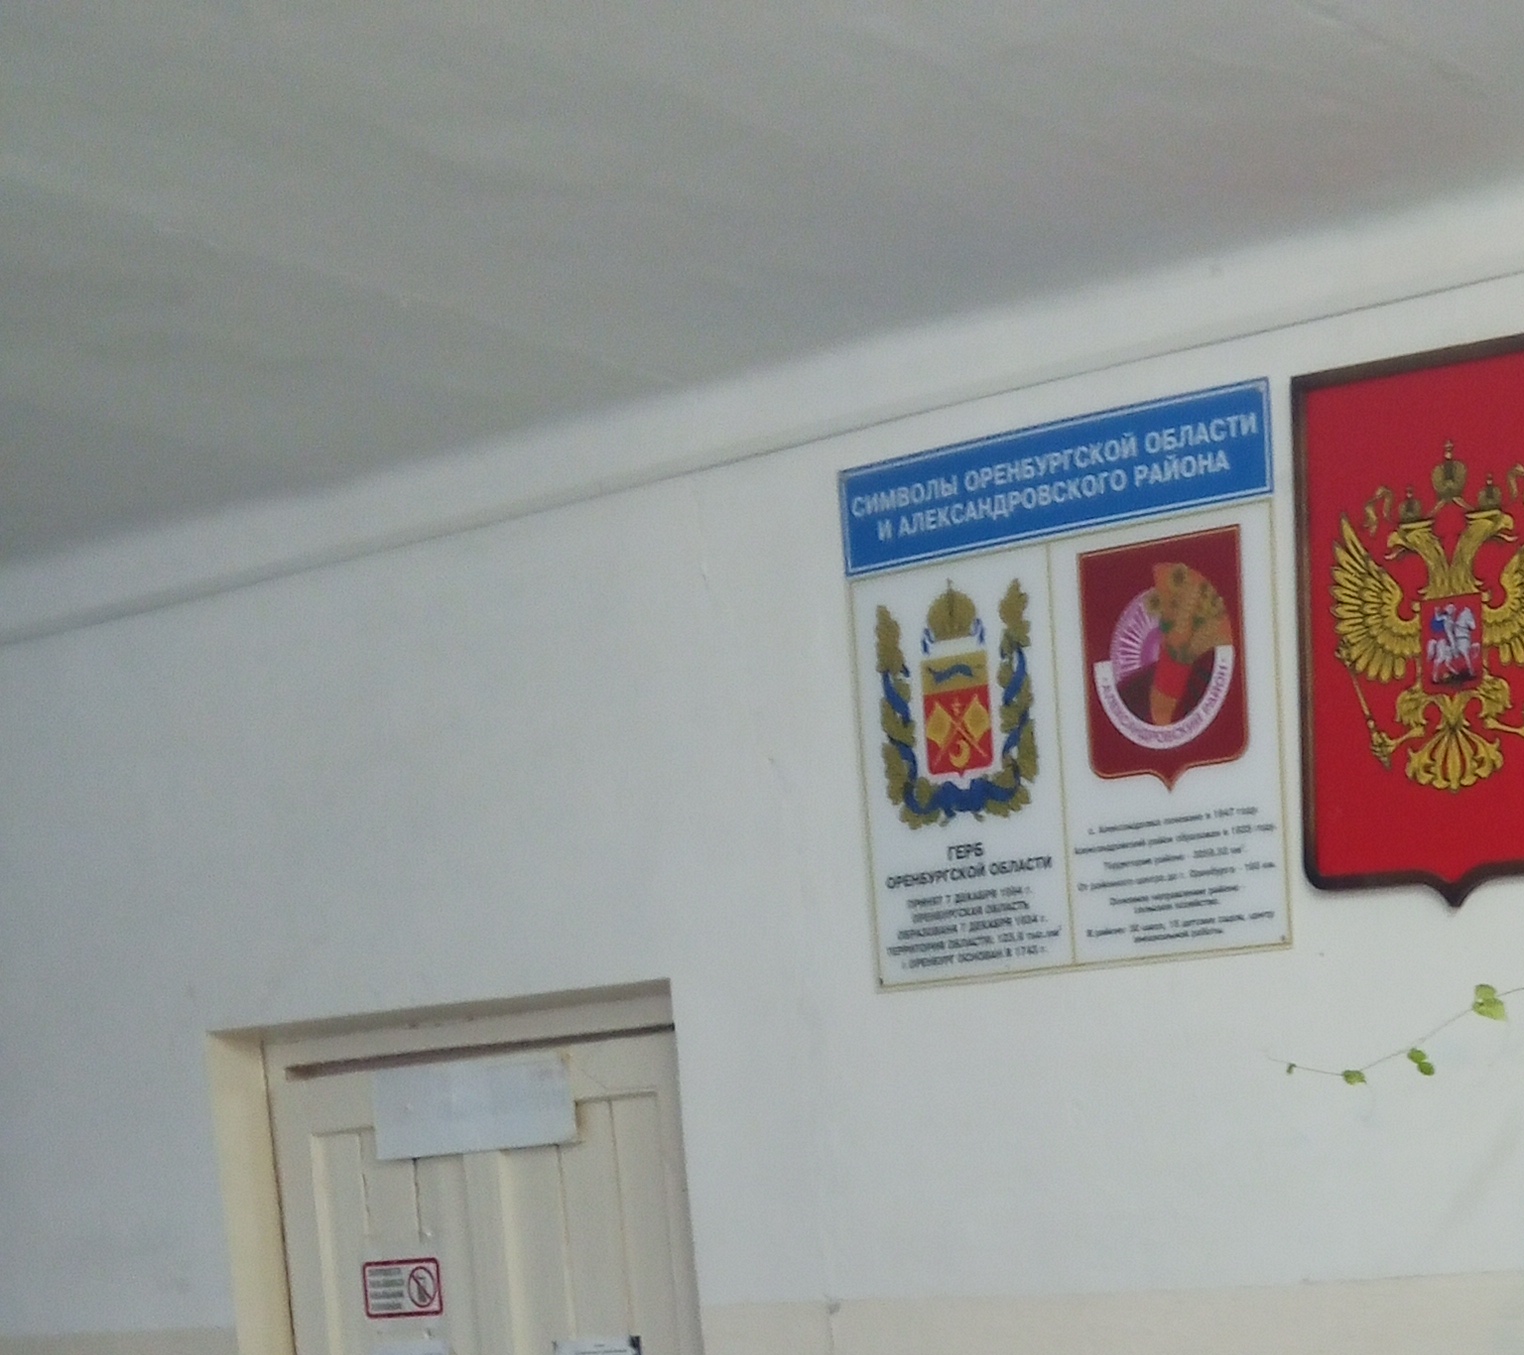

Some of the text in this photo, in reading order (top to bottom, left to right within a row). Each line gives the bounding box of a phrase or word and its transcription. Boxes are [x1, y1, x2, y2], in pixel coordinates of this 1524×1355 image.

[851, 412, 1258, 519] СИМВОЛЫ ОРЕНБУРГСКОЙ ОБЛАСТИ
[878, 450, 1230, 541] И АЛЕКСАНДРОВСКОГО РАЙОНА
[886, 856, 1053, 889] ОРЕНБУРГСКОЙ ОБЛАСТИ
[947, 842, 984, 861] ГЕРБ
